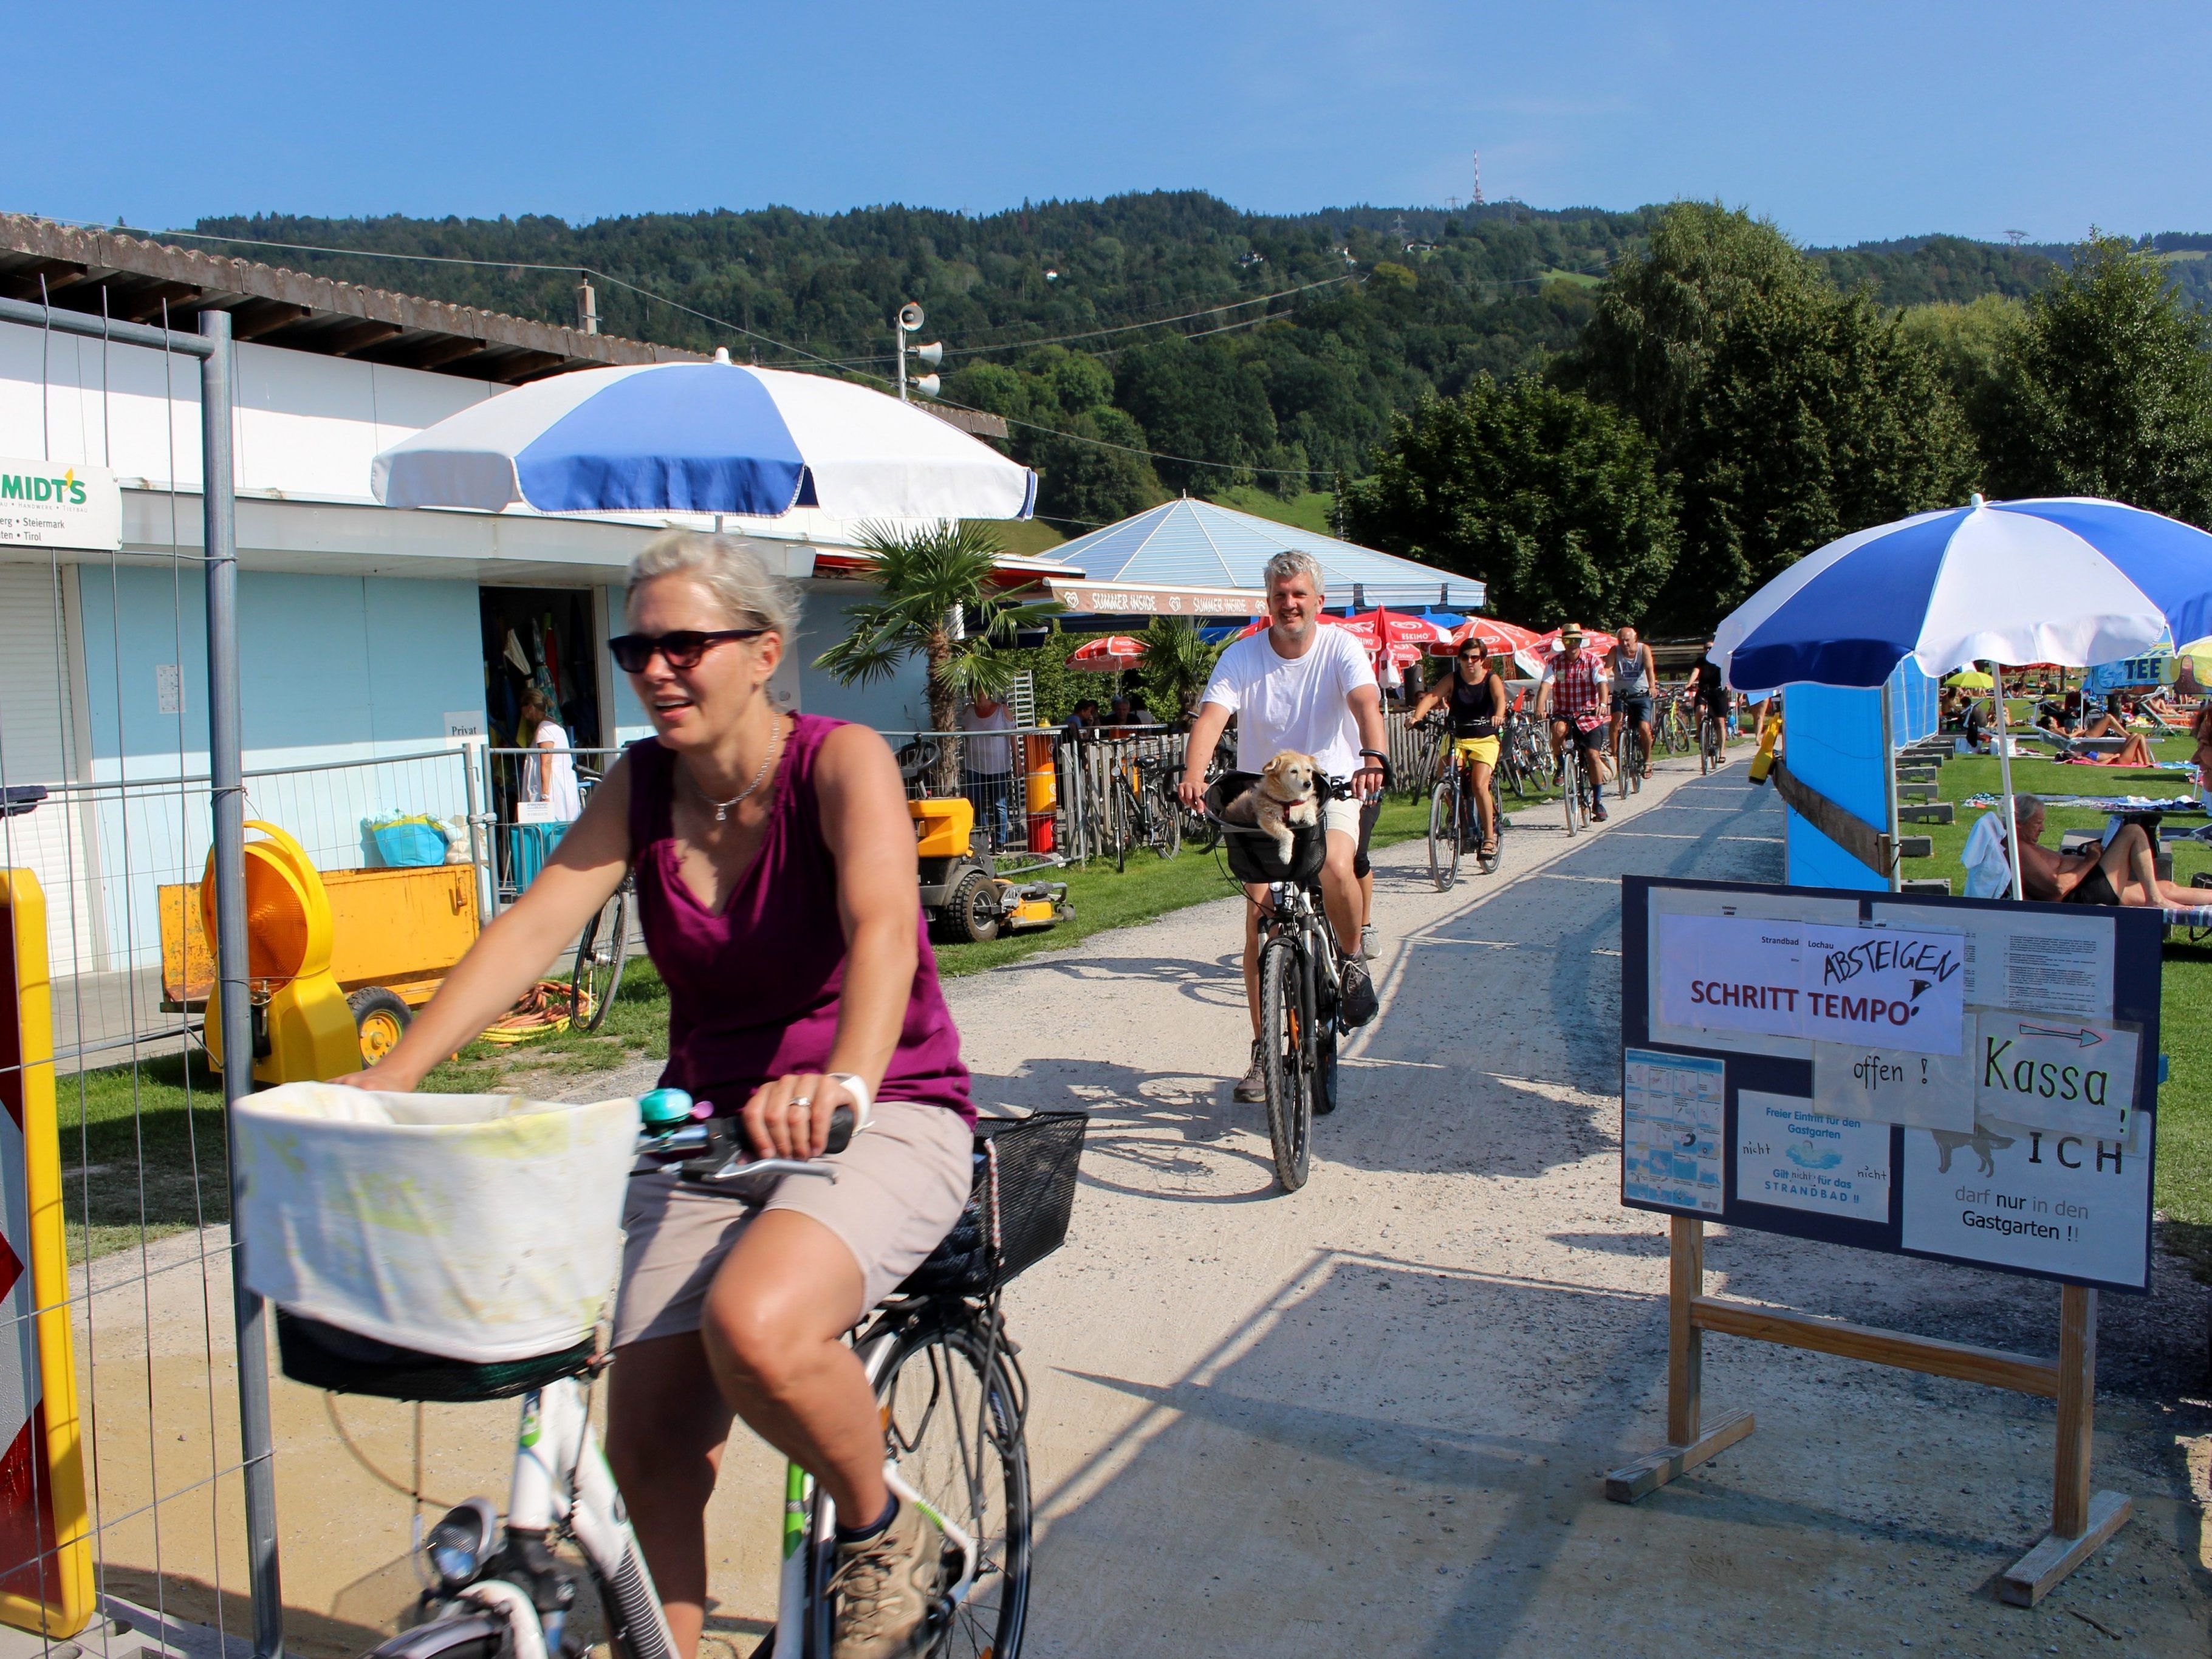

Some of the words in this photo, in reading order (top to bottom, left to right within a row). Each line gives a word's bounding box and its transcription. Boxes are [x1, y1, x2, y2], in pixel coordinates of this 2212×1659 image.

[23, 517, 65, 529] Steiermark
[0, 530, 13, 540] ten
[24, 531, 41, 541] Tirol
[1092, 592, 1129, 611] SUMMER
[1130, 594, 1157, 612] INSIDE
[2125, 657, 2161, 680] TEE
[451, 725, 476, 736] Privat
[1761, 936, 1799, 945] Strandbad
[1807, 940, 1834, 949] Lochau
[1824, 940, 1960, 986] ABSTEIGEN
[1691, 980, 1799, 1012] SCHRITT
[1853, 1056, 1903, 1090] offen
[1984, 1036, 2108, 1107] Kassa
[1765, 1107, 1792, 1119] Freier
[1842, 1117, 1861, 1128] den
[1788, 1124, 1841, 1140] Gastgarten
[1743, 1141, 1771, 1155] nicht
[2028, 1131, 2123, 1174] ICH
[1773, 1168, 1789, 1179] Gilt
[1818, 1175, 1831, 1186] für
[1834, 1178, 1852, 1189] das
[1857, 1165, 1887, 1180] nicht
[1764, 1181, 1847, 1202] STRANDBAD
[1954, 1185, 1991, 1205] darf
[1996, 1193, 2027, 1210] nur
[2032, 1196, 2048, 1213] in
[2054, 1200, 2089, 1220] den
[1962, 1210, 2060, 1240] Gastgarten
